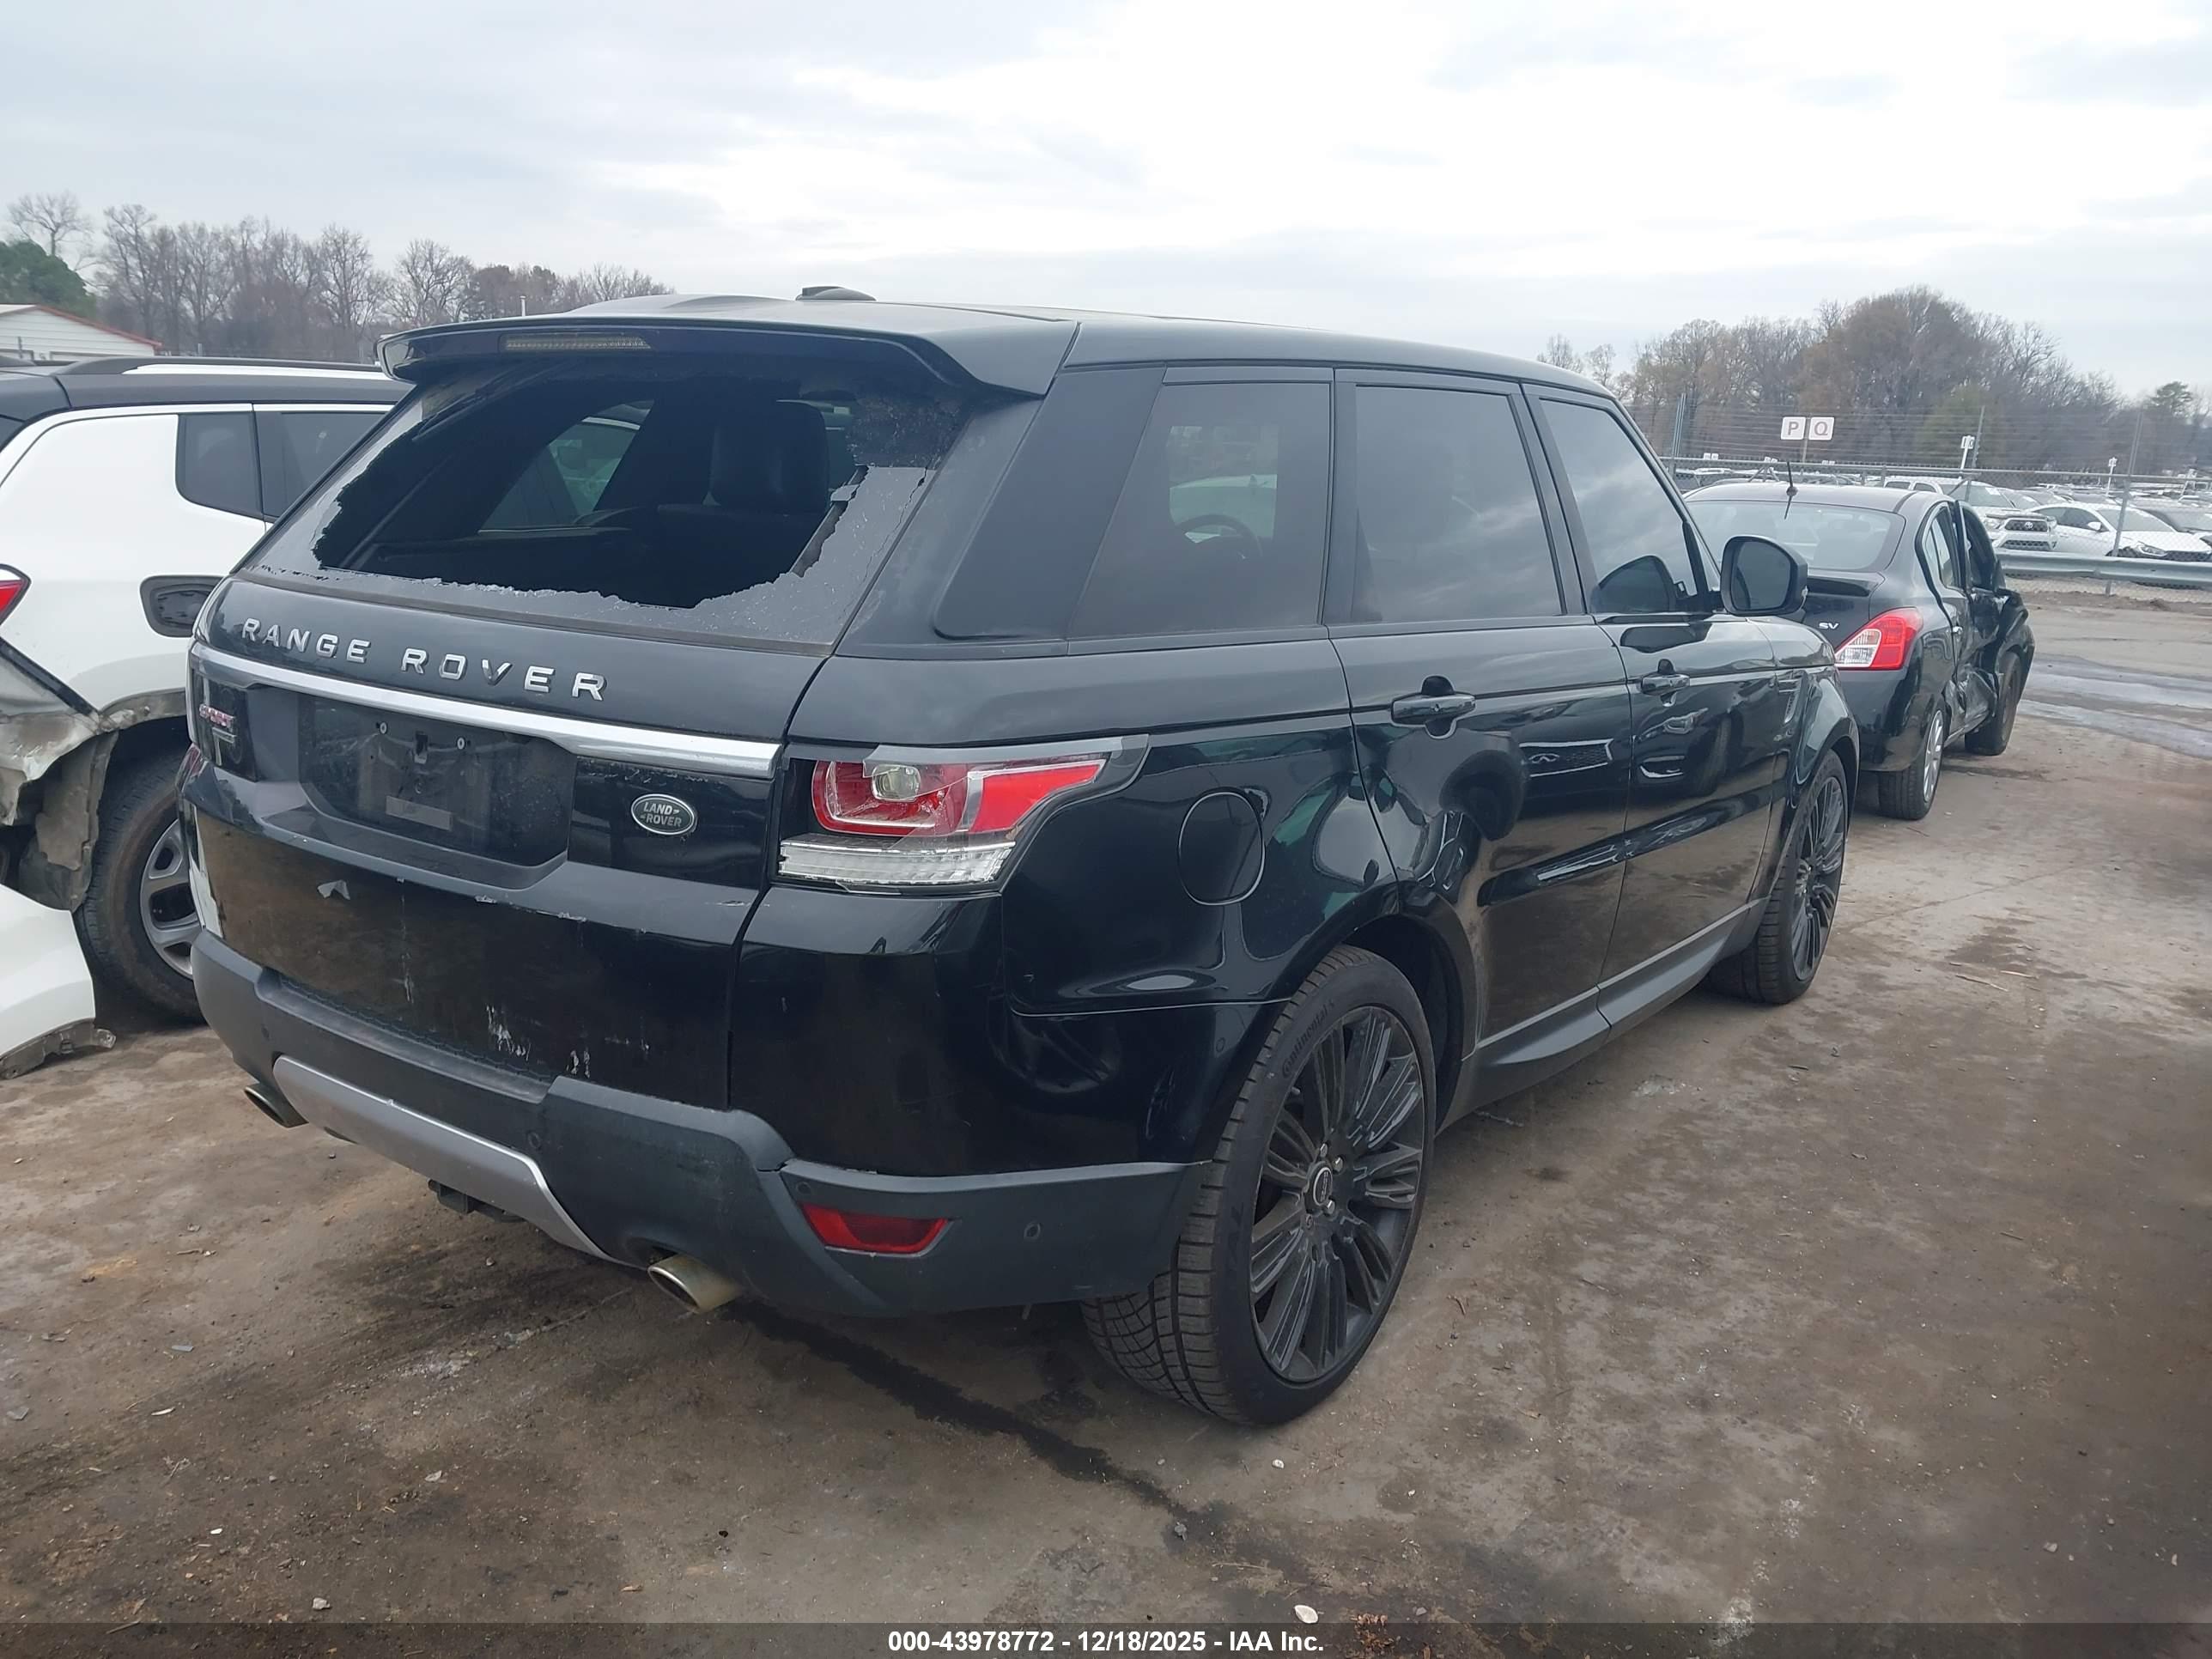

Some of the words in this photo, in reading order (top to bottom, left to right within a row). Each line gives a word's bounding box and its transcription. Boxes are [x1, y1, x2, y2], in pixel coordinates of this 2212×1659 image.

[1788, 421, 1799, 435] P
[1814, 421, 1829, 436] Q
[241, 617, 371, 664] RANGE
[400, 647, 607, 702] ROVER
[643, 801, 673, 816] LAND
[646, 812, 683, 827] ROVER
